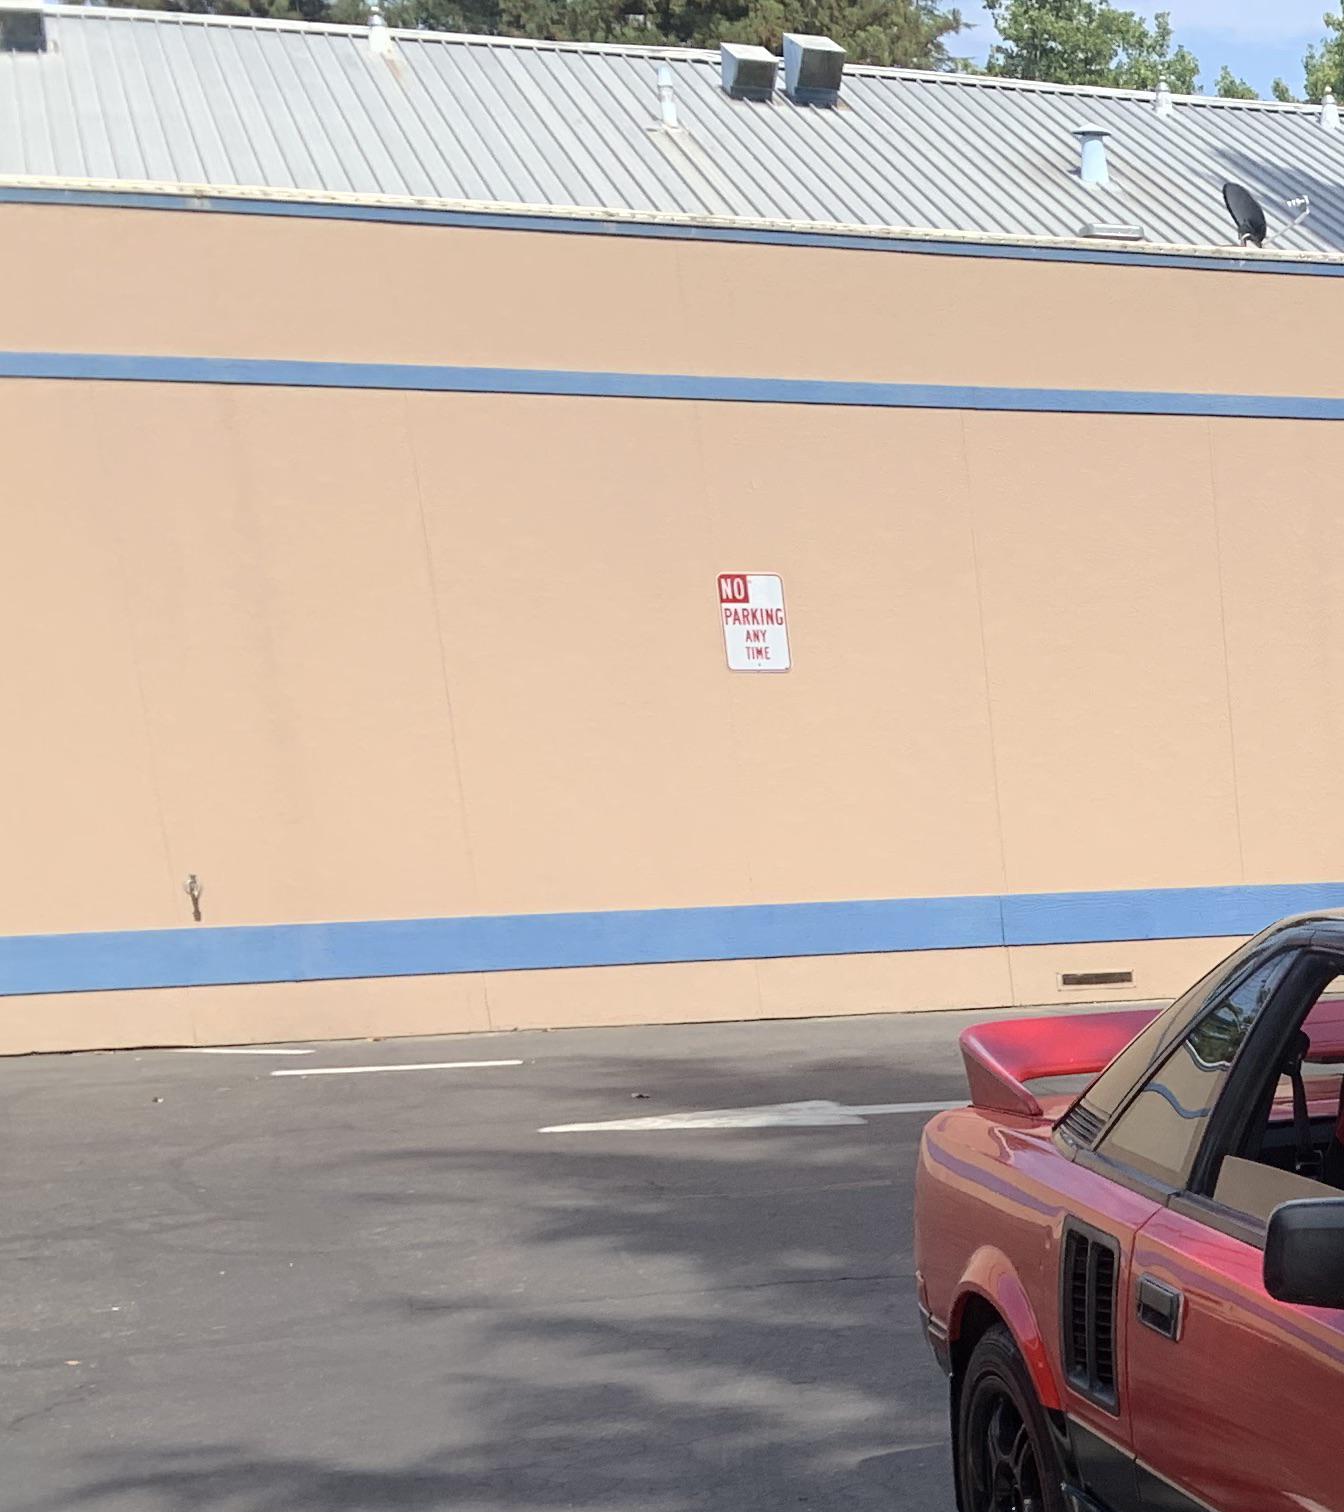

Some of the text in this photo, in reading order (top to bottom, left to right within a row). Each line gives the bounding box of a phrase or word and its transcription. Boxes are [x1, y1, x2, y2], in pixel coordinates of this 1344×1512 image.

[720, 577, 745, 600] NO
[723, 607, 784, 626] PARKING
[745, 629, 767, 643] ANY
[745, 646, 771, 660] TIME
